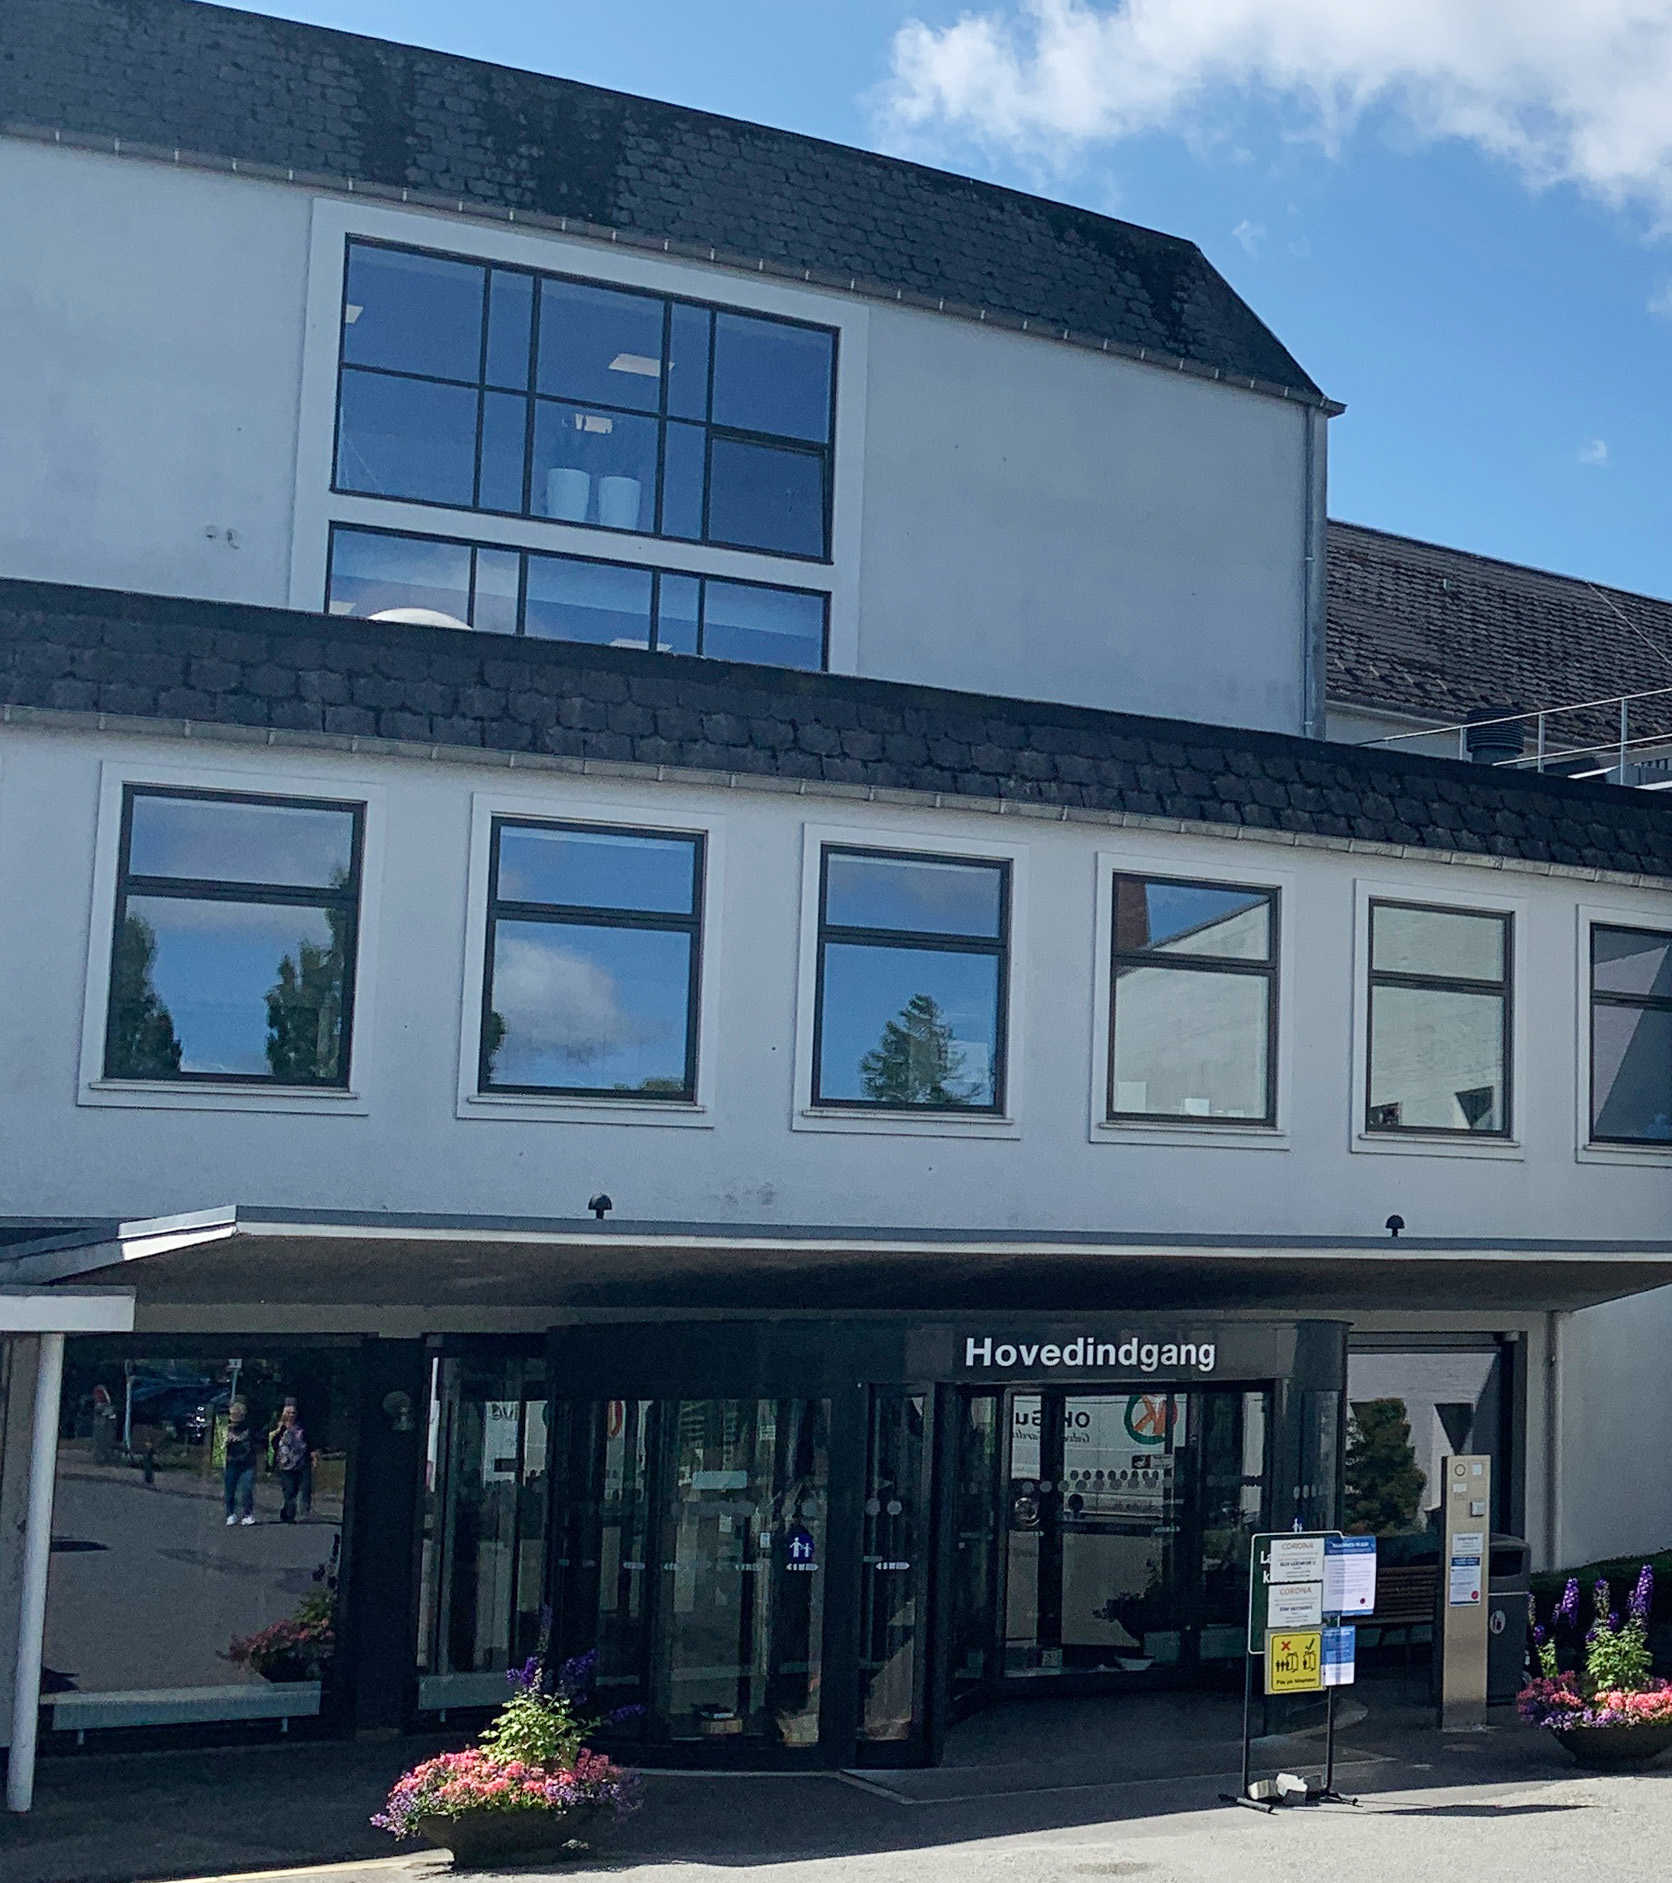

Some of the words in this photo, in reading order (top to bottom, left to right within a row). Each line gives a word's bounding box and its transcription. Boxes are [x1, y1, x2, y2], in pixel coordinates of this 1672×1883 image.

[965, 1337, 1216, 1372] Hovedindgang
[1281, 1542, 1314, 1550] CORONA
[1280, 1587, 1312, 1595] CORONA
